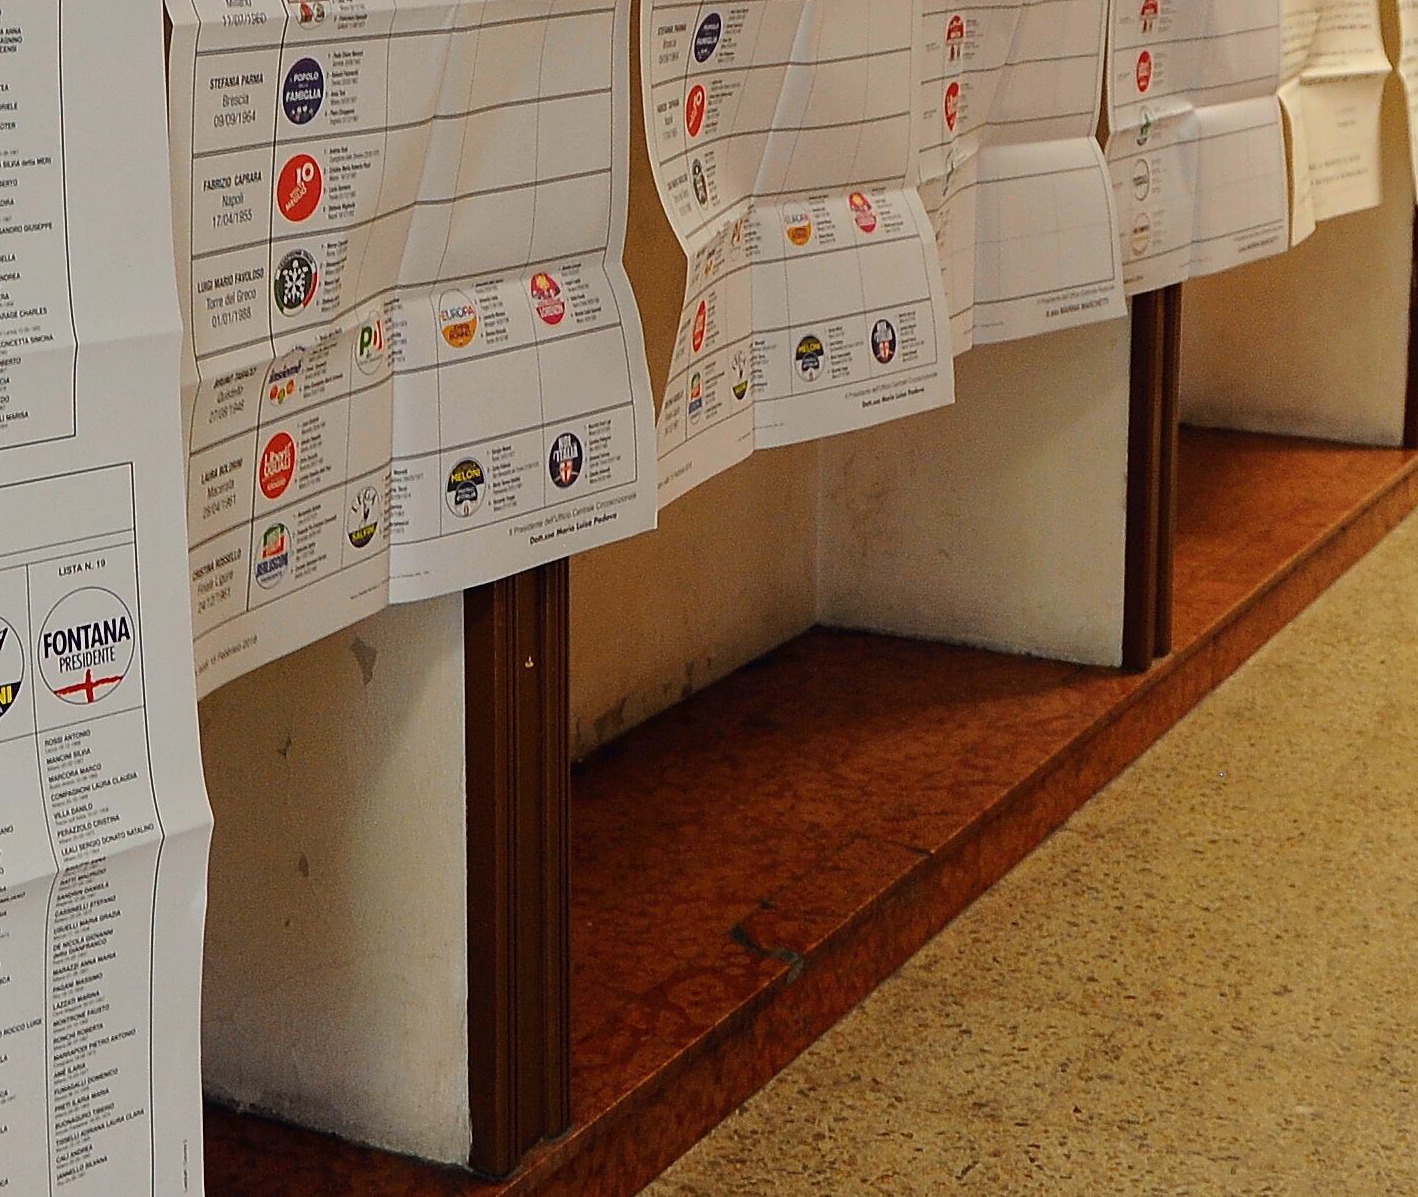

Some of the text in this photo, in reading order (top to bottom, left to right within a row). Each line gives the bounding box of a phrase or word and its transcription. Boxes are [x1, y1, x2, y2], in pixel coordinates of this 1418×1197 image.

[59, 559, 106, 576] LISTA N. 19
[43, 616, 131, 659] FONTANA
[59, 646, 116, 673] PRESIDENTE
